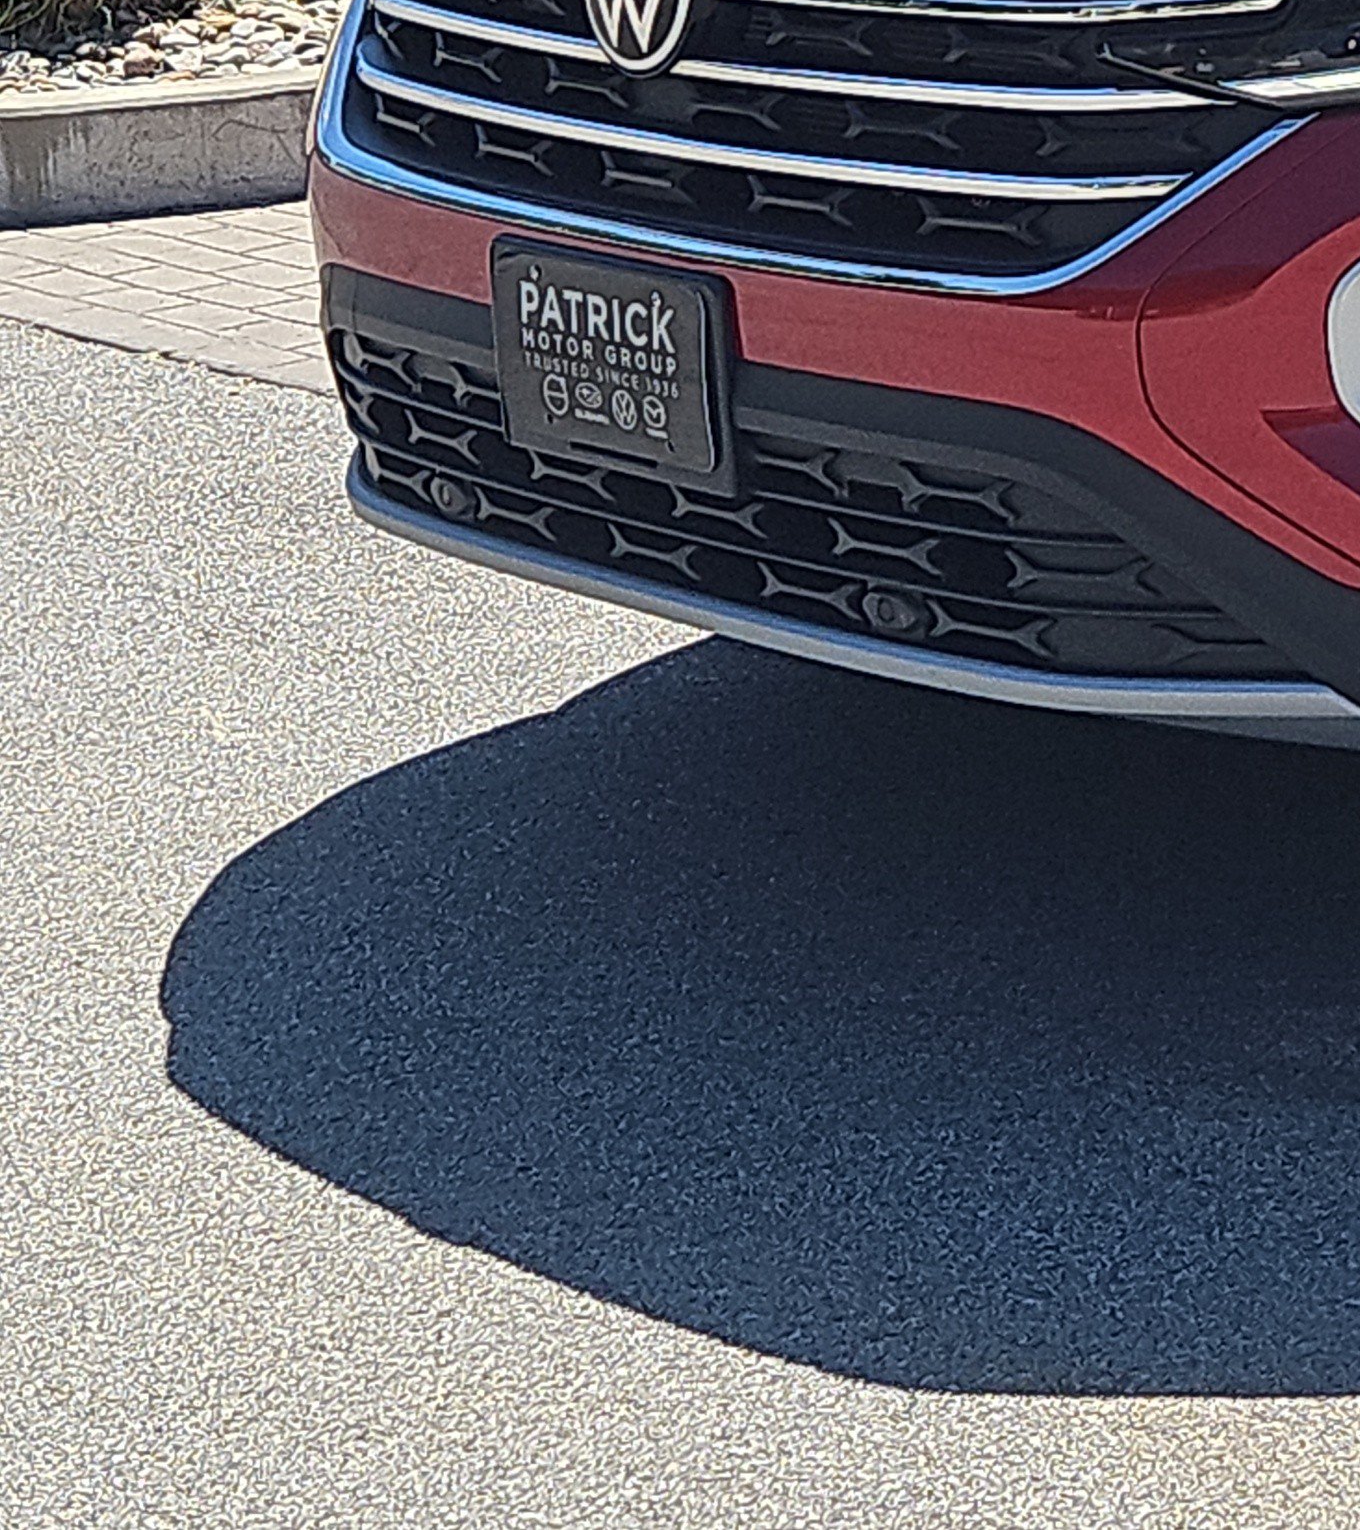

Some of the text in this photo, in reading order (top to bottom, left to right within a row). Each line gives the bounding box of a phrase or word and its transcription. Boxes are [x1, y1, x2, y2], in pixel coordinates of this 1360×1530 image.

[519, 280, 676, 354] PATRICK
[521, 327, 677, 377] MOTOR GROUP
[525, 351, 589, 379] TRUSTED
[596, 366, 640, 391] SINCE
